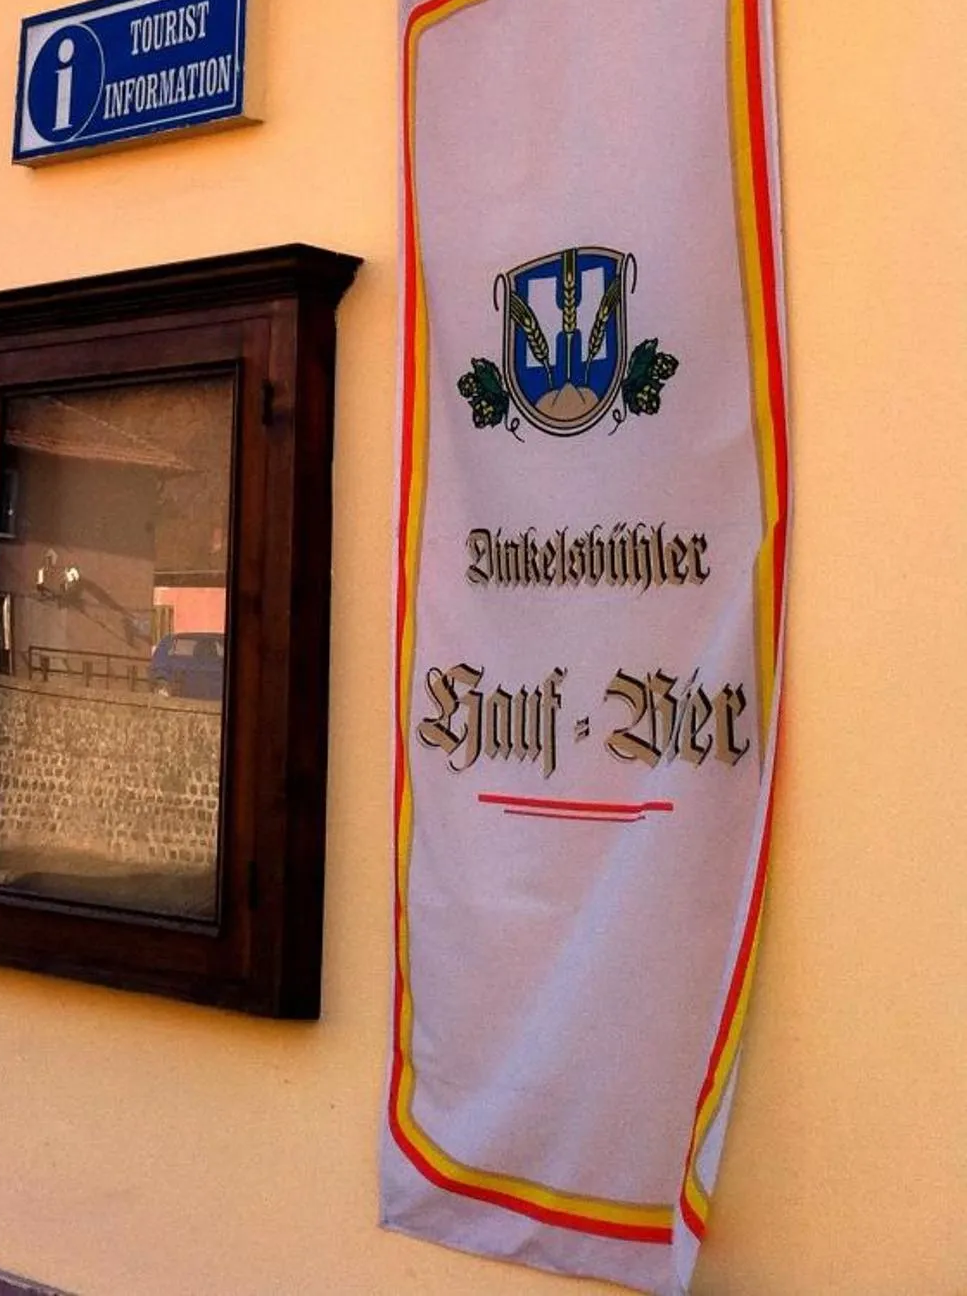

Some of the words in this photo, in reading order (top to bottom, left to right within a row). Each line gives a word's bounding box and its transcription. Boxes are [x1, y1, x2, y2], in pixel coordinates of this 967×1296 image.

[129, 0, 210, 56] TOURIST
[102, 54, 232, 120] INFORMATION
[465, 520, 712, 596] Dinkelsbühler
